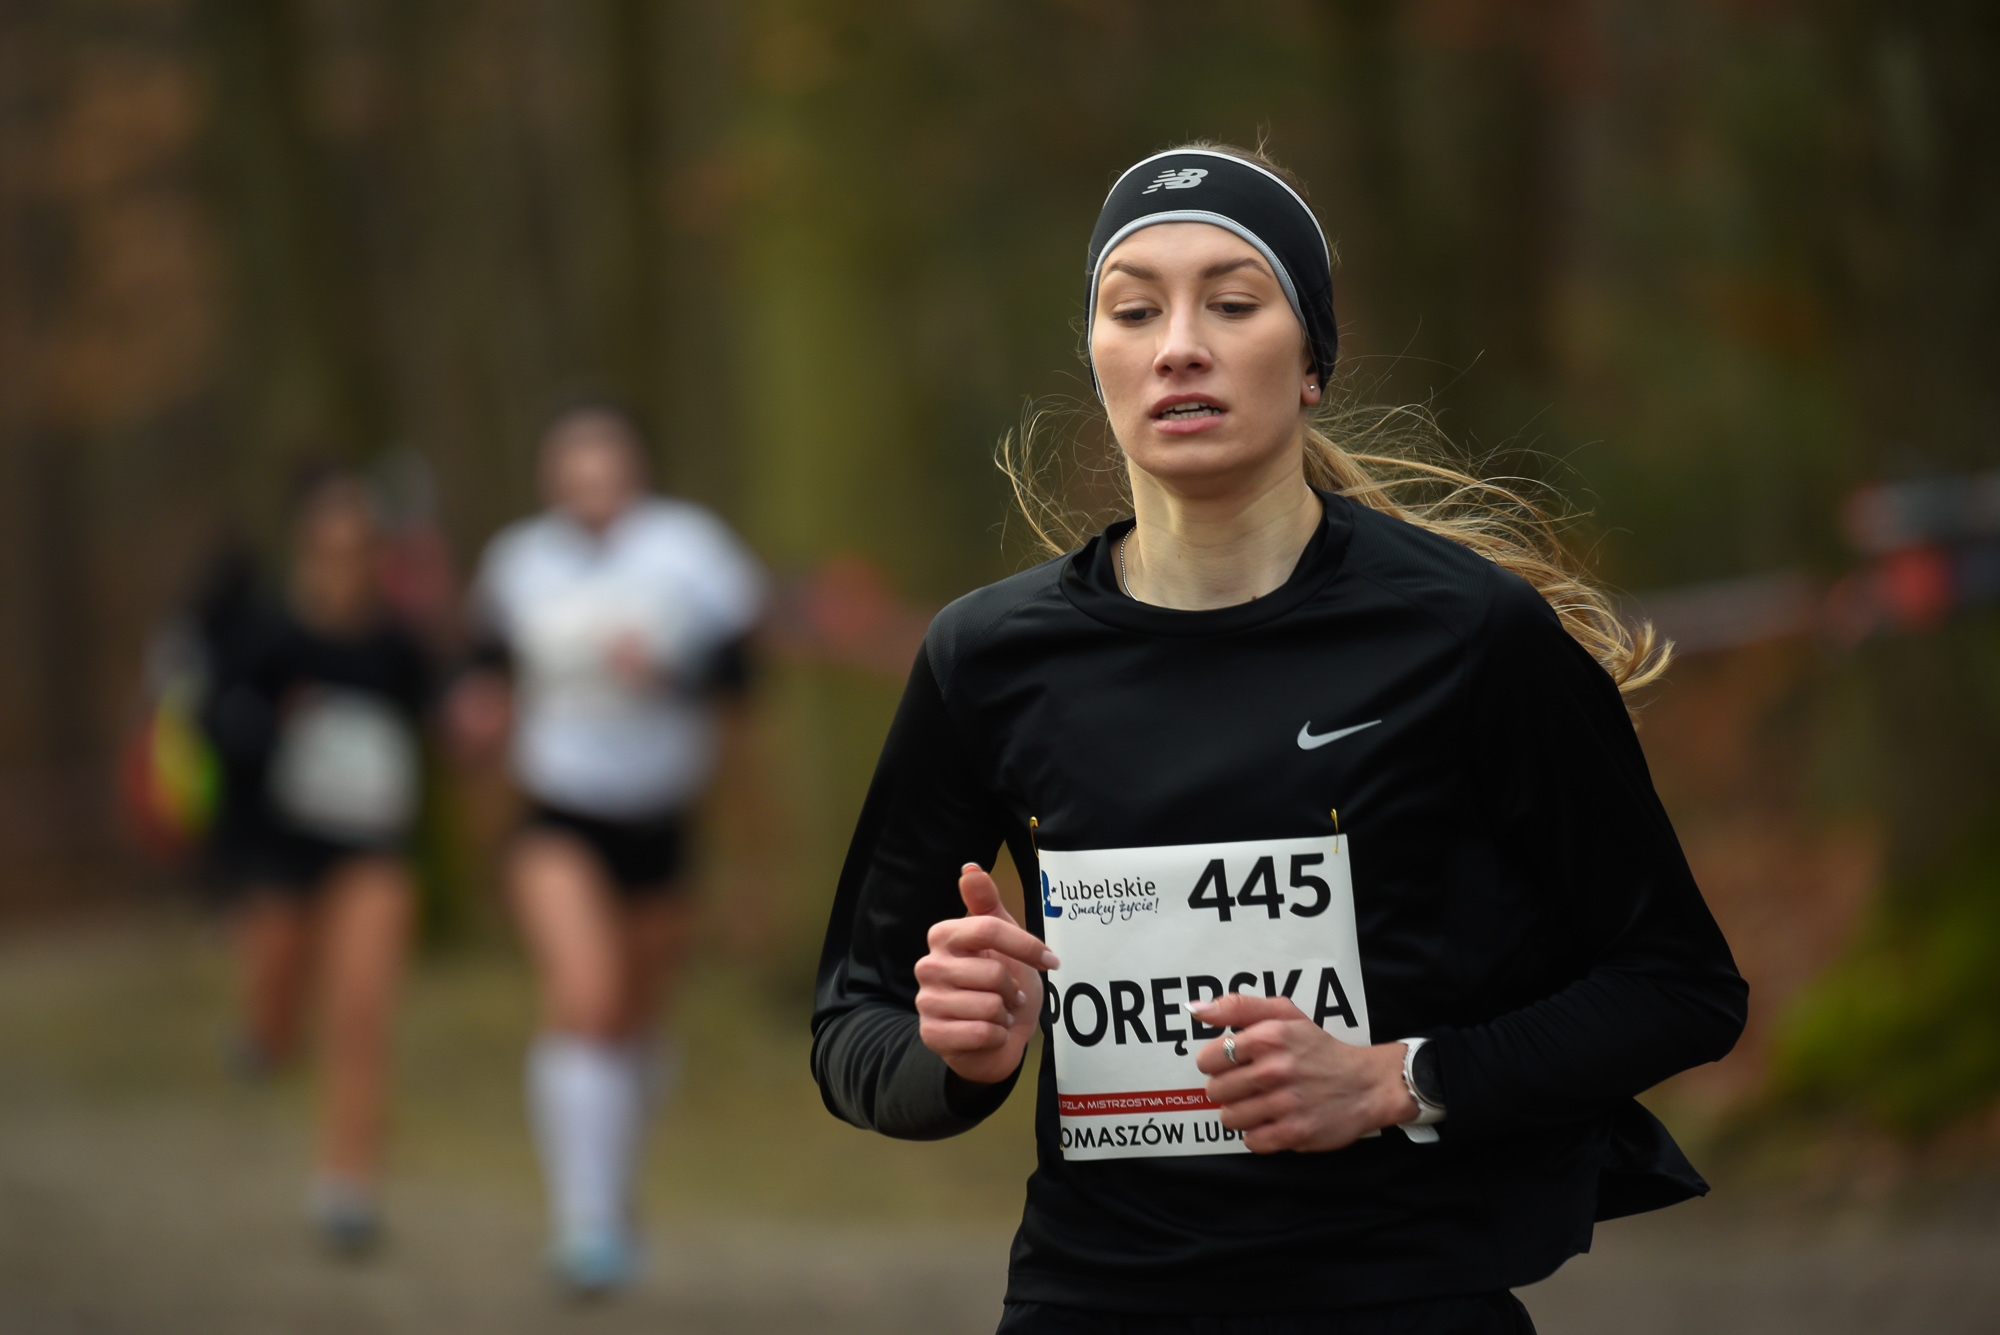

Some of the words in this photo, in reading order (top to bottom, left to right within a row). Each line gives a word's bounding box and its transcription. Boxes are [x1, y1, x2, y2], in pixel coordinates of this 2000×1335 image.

[1059, 876, 1157, 901] lubelskie
[1187, 852, 1332, 922] 445
[1068, 901, 1117, 926] Smakuj
[1119, 897, 1160, 922] życie!
[1061, 1100, 1086, 1110] PZLA
[1087, 1096, 1164, 1110] MISTRZOSTWA
[1165, 1094, 1204, 1106] POLSKI
